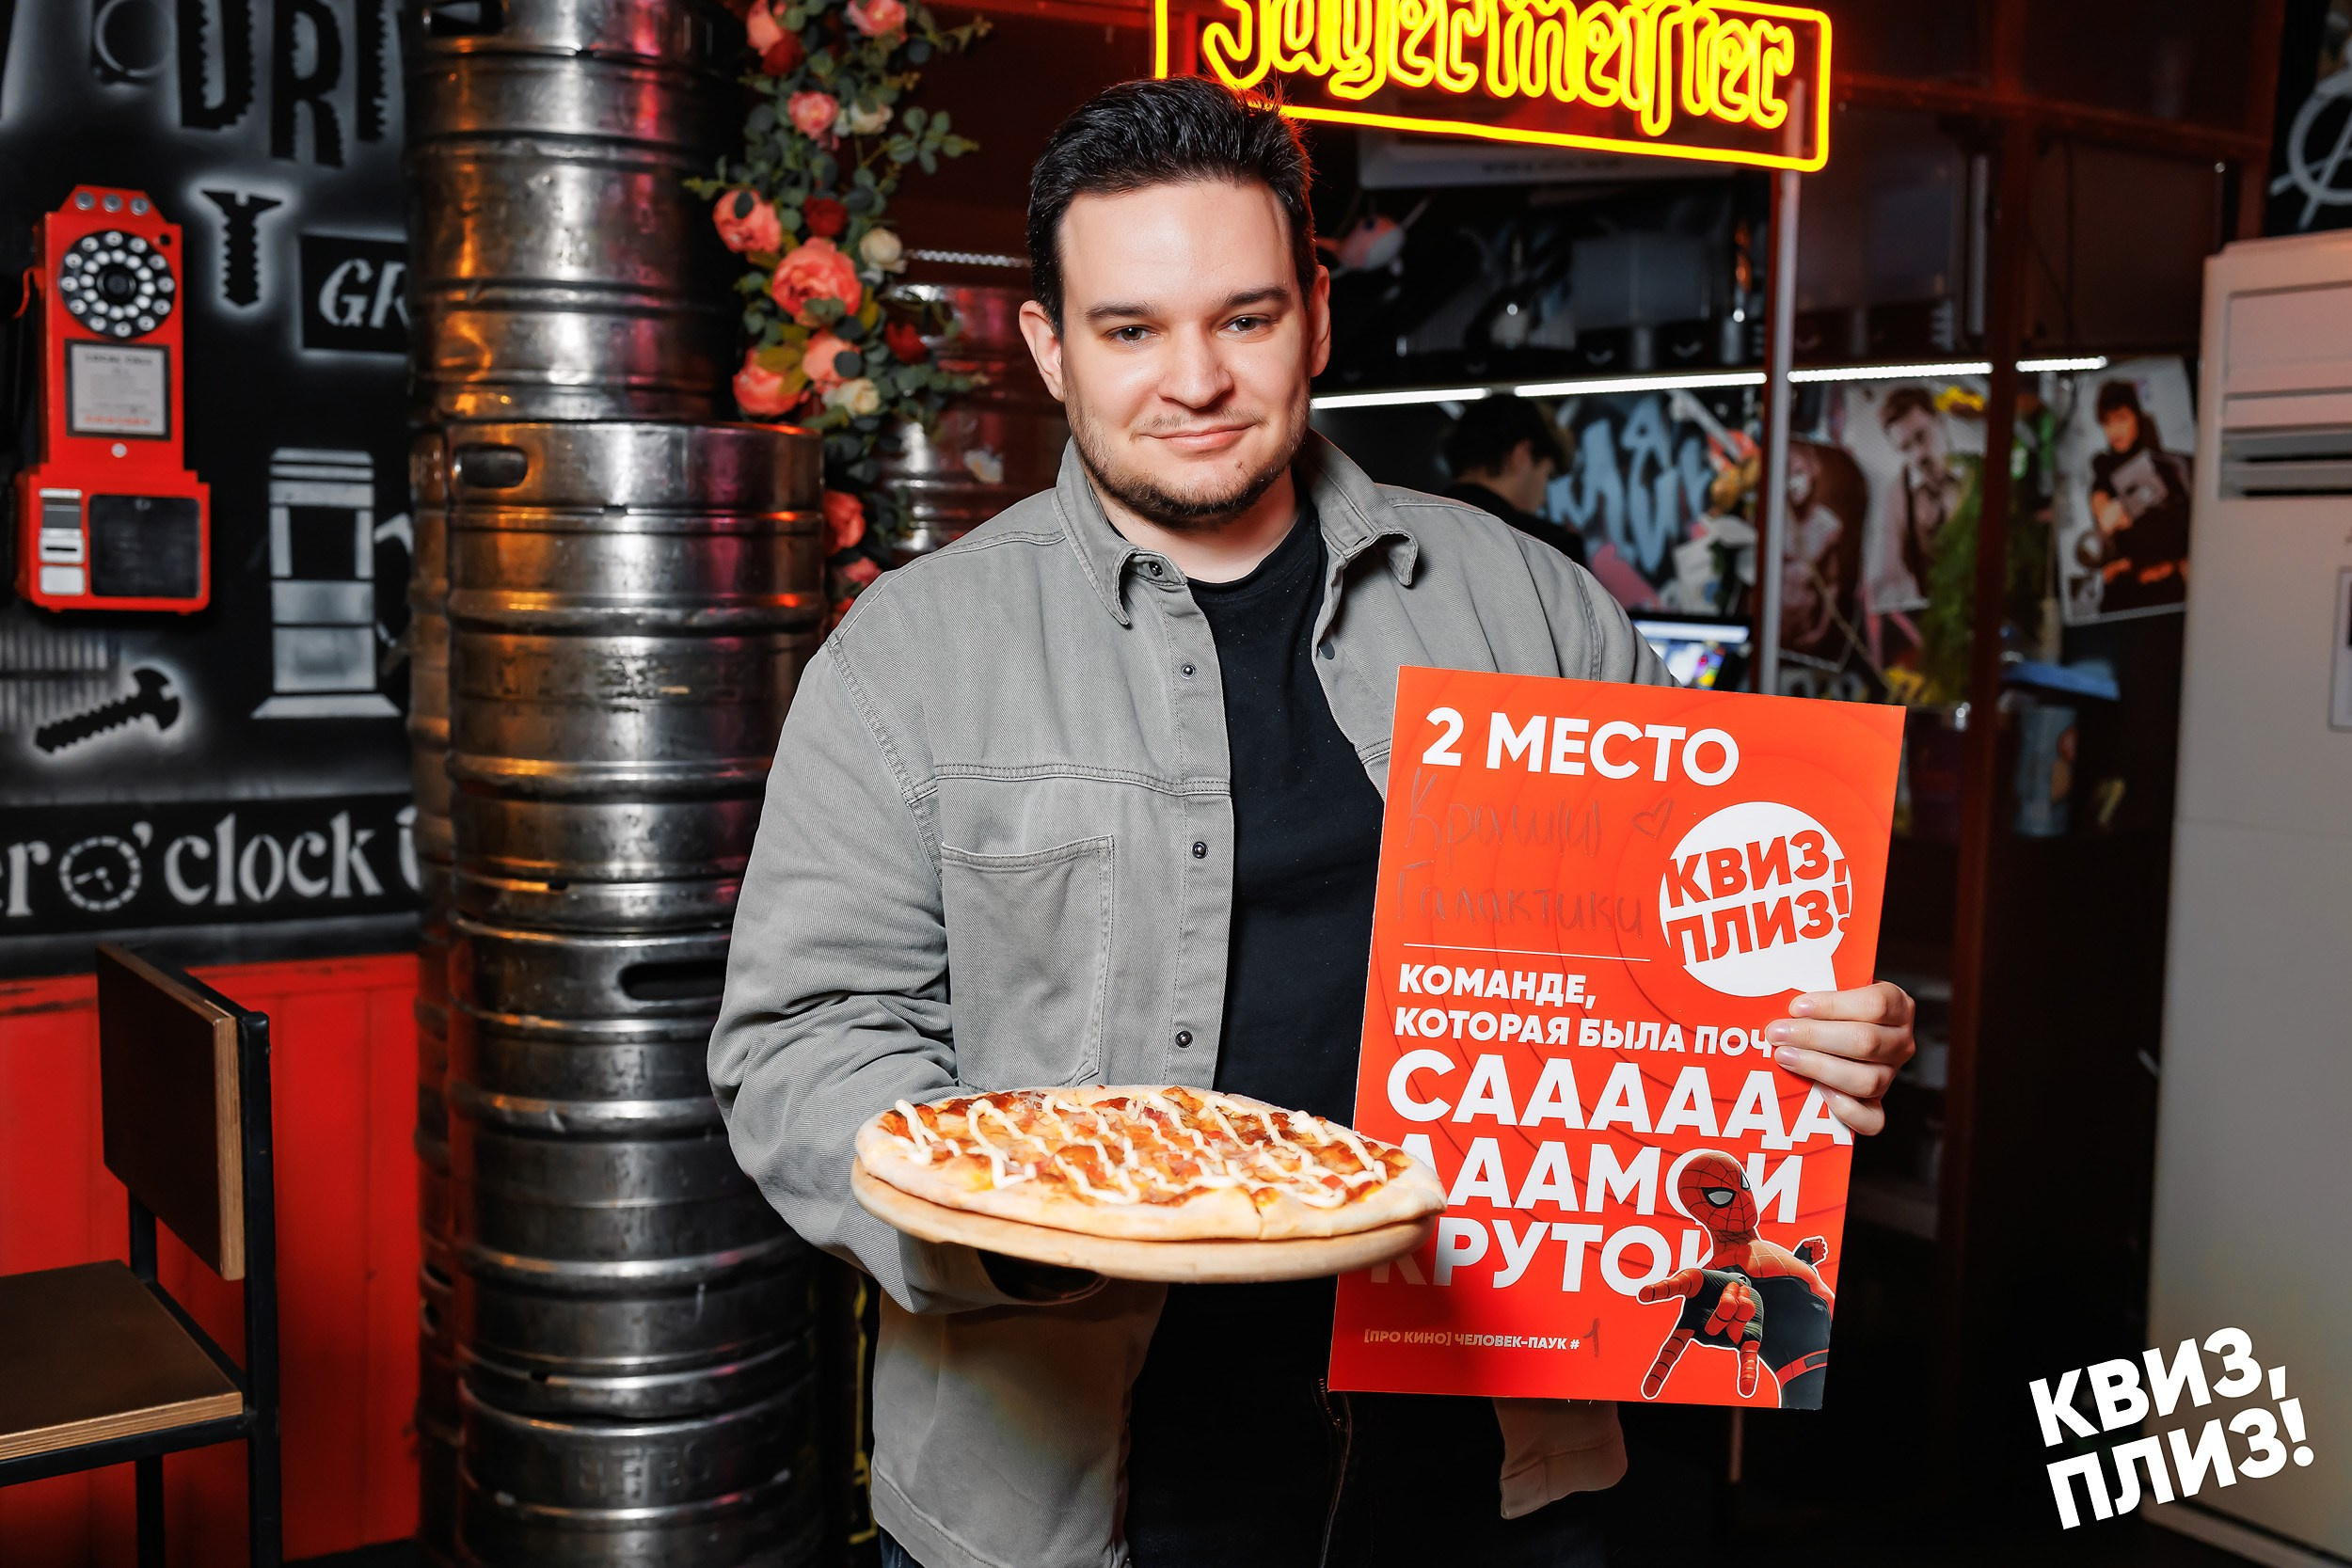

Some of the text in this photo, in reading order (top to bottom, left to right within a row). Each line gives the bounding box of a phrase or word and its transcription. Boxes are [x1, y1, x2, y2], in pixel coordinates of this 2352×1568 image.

[1422, 706, 1740, 786] 2 МЕСТО
[1398, 860, 1643, 939] Галактики
[1664, 830, 1848, 909] КВИЗ,
[1666, 883, 1851, 966] ПЛИЗ!
[1398, 963, 1597, 1009] КОМАНДЕ,
[1394, 1006, 1772, 1058] КОТОРАЯ БЫЛА ПОЧ
[1364, 1328, 1401, 1343] [ПРО
[1404, 1331, 1452, 1346] КИНО]
[1454, 1333, 1567, 1350] ЧЕЛОВЕК-ПАУК
